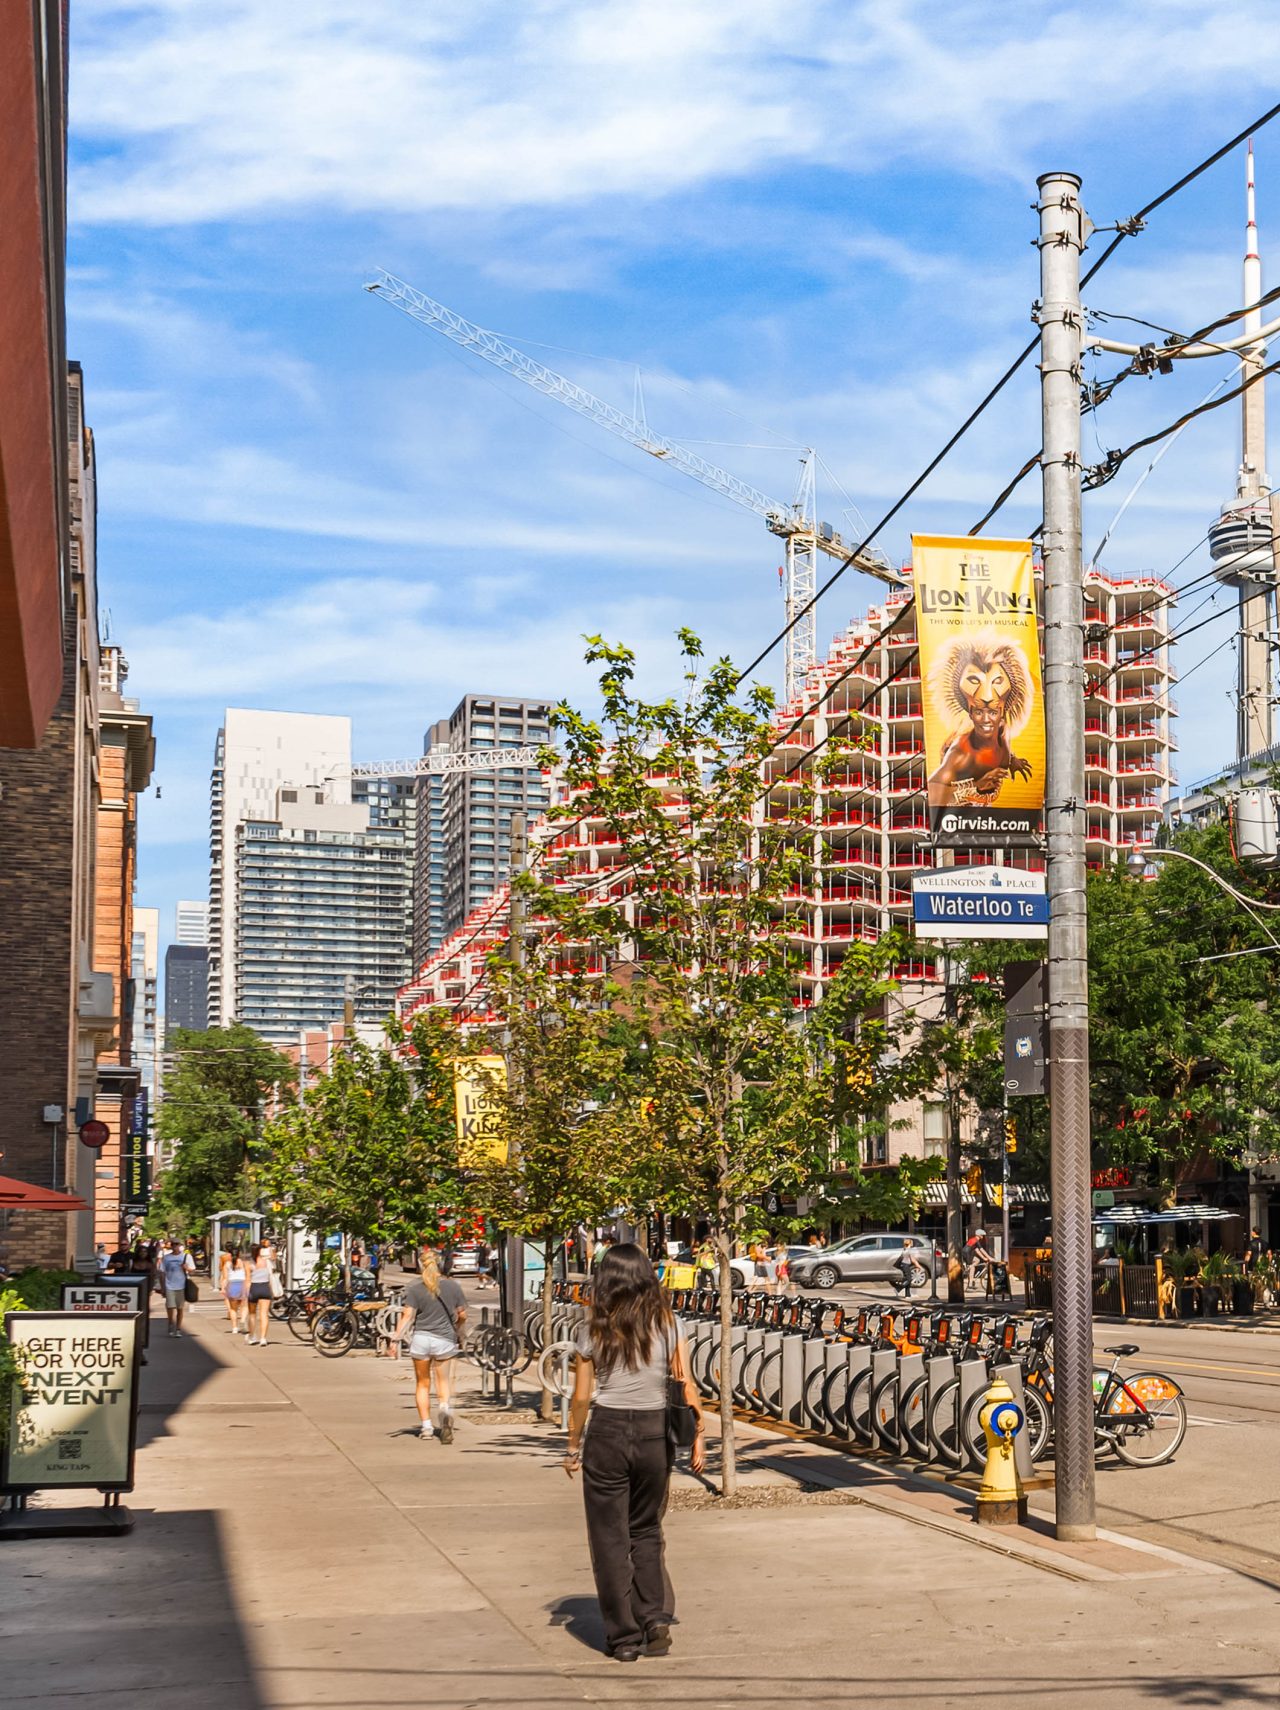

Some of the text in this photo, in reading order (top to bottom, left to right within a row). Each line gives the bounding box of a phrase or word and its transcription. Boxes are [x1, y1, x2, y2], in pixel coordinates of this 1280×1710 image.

[959, 563, 990, 577] THE
[919, 583, 1032, 615] LION KING
[942, 814, 1030, 833] mirvish.com
[919, 878, 1037, 888] WELLINGTON PLACE
[930, 895, 1034, 917] Waterloo Te
[71, 1290, 132, 1304] LET'S
[27, 1337, 122, 1352] GET HERE
[23, 1353, 126, 1369] FOR YOUR
[32, 1371, 116, 1387] NEXT
[21, 1388, 124, 1406] EVENT
